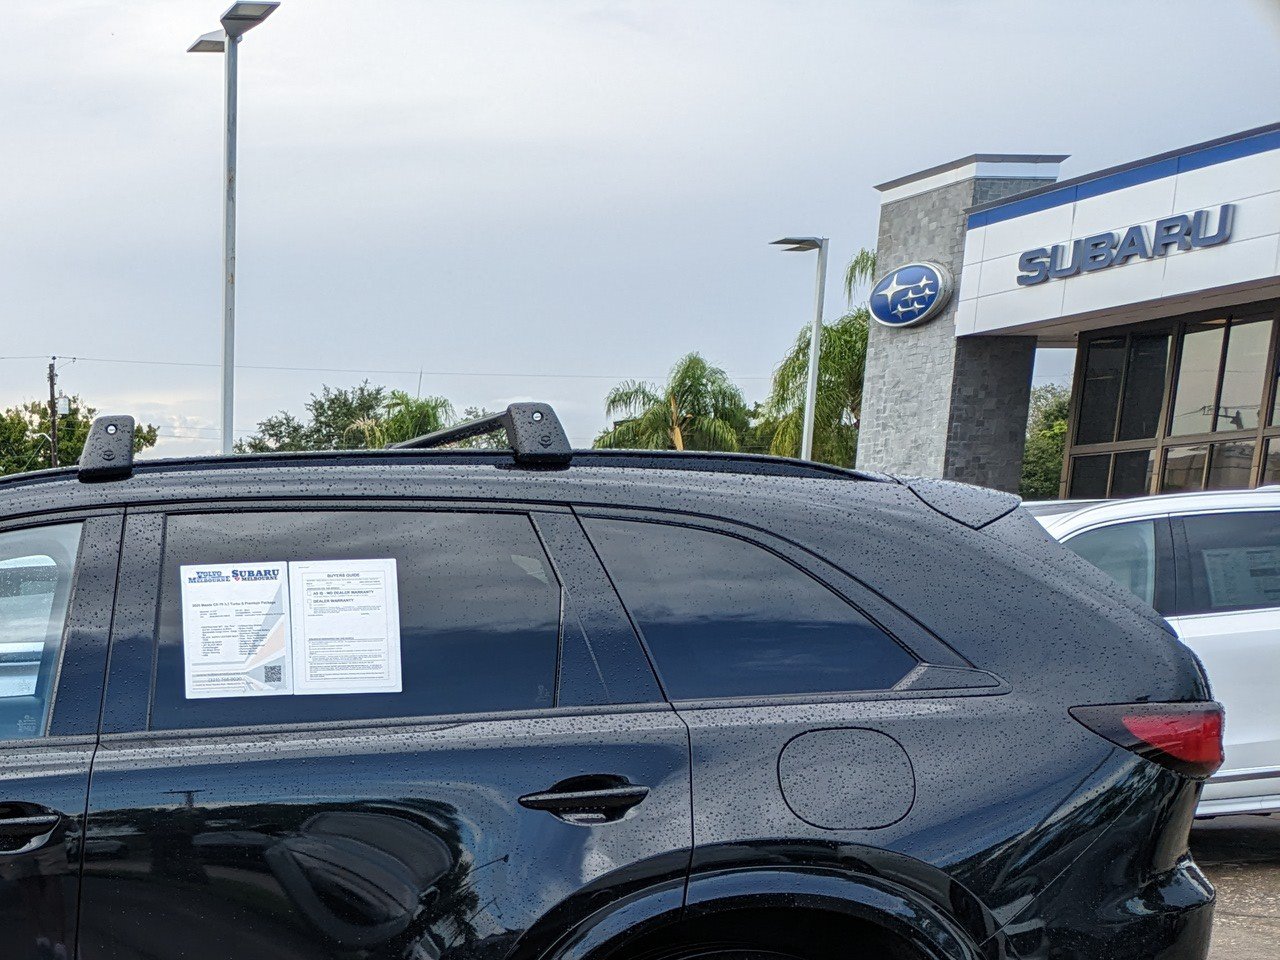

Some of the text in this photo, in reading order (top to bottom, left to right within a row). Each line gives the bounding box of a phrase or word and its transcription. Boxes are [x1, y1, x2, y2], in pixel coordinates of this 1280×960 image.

[1016, 203, 1237, 287] SUBARU
[195, 570, 222, 579] VOLVO
[231, 569, 280, 578] SUBARU
[188, 576, 231, 584] MELBOURNE
